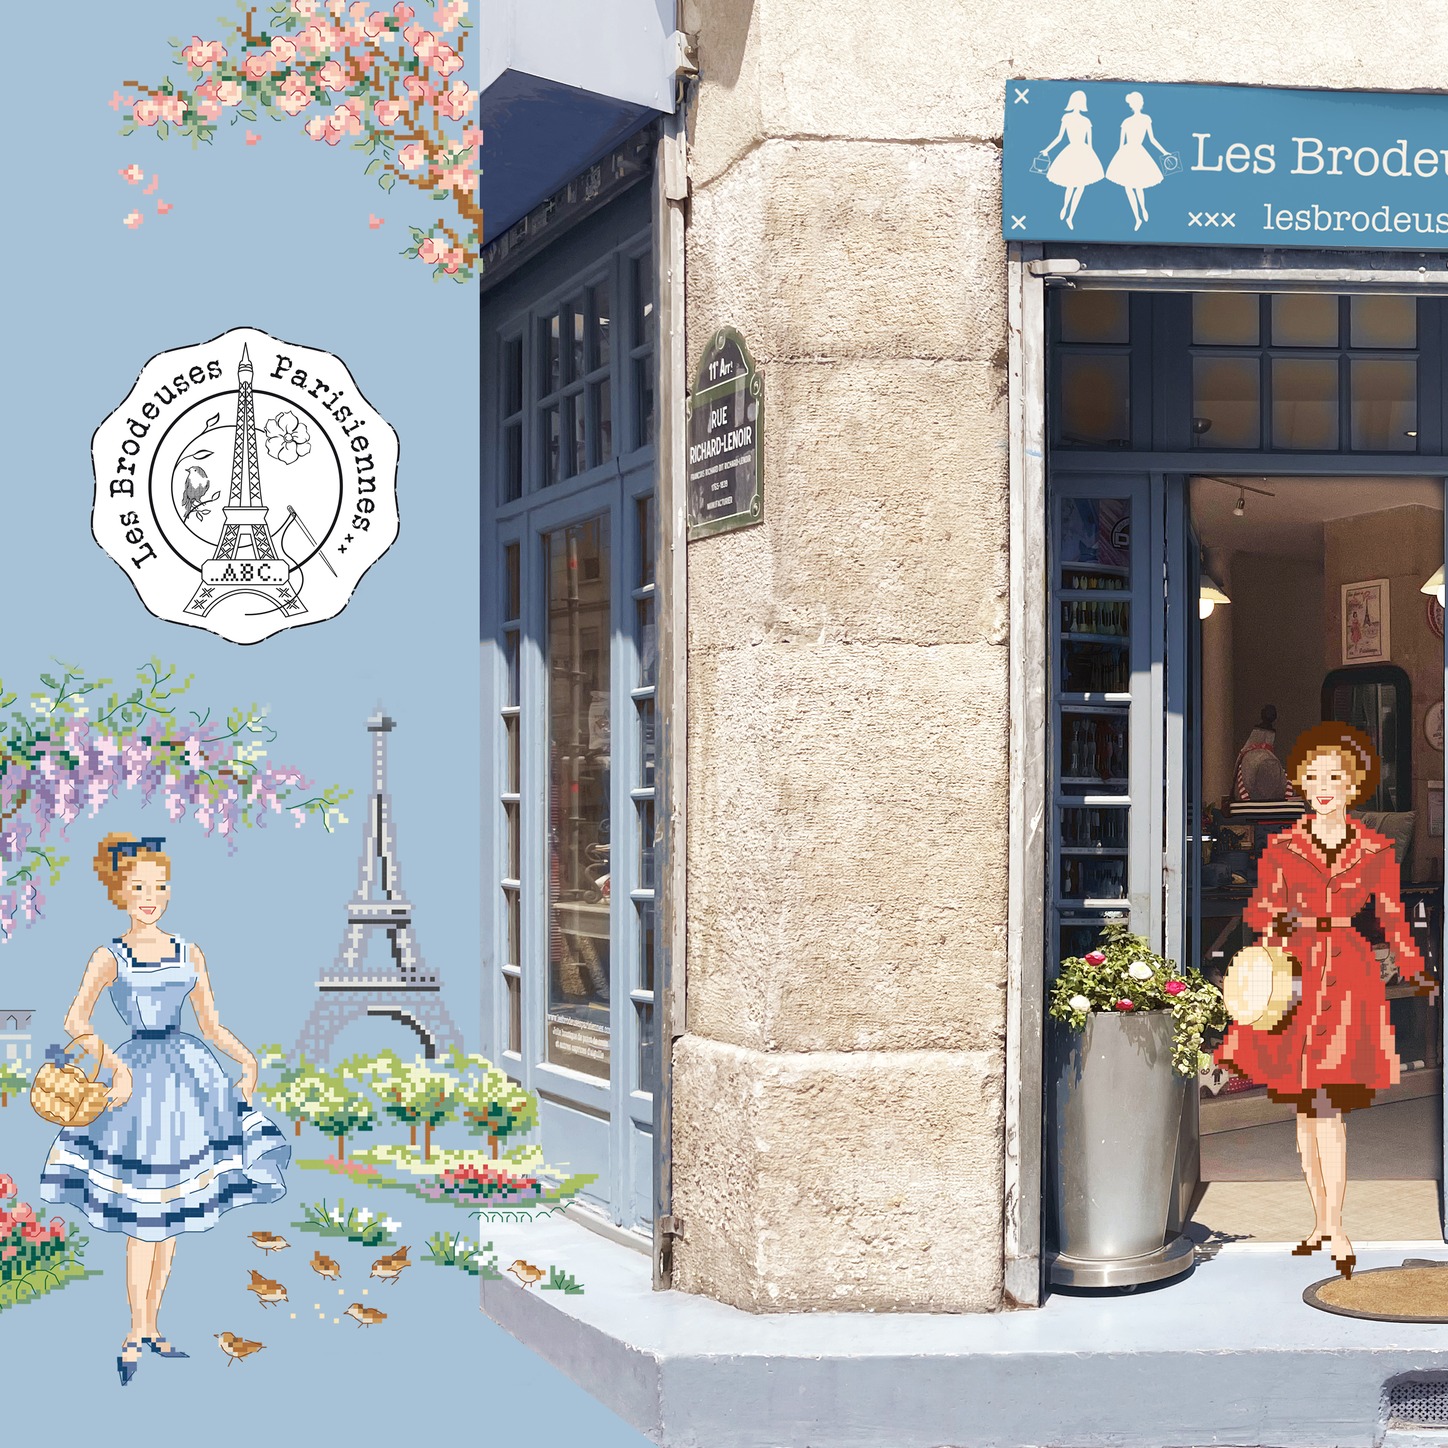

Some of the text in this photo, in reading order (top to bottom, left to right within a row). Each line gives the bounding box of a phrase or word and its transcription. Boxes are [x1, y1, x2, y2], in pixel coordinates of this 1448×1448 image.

[1191, 132, 1276, 174] Les
[711, 406, 728, 427] RUE
[689, 425, 752, 465] RICHARD-LENOIR
